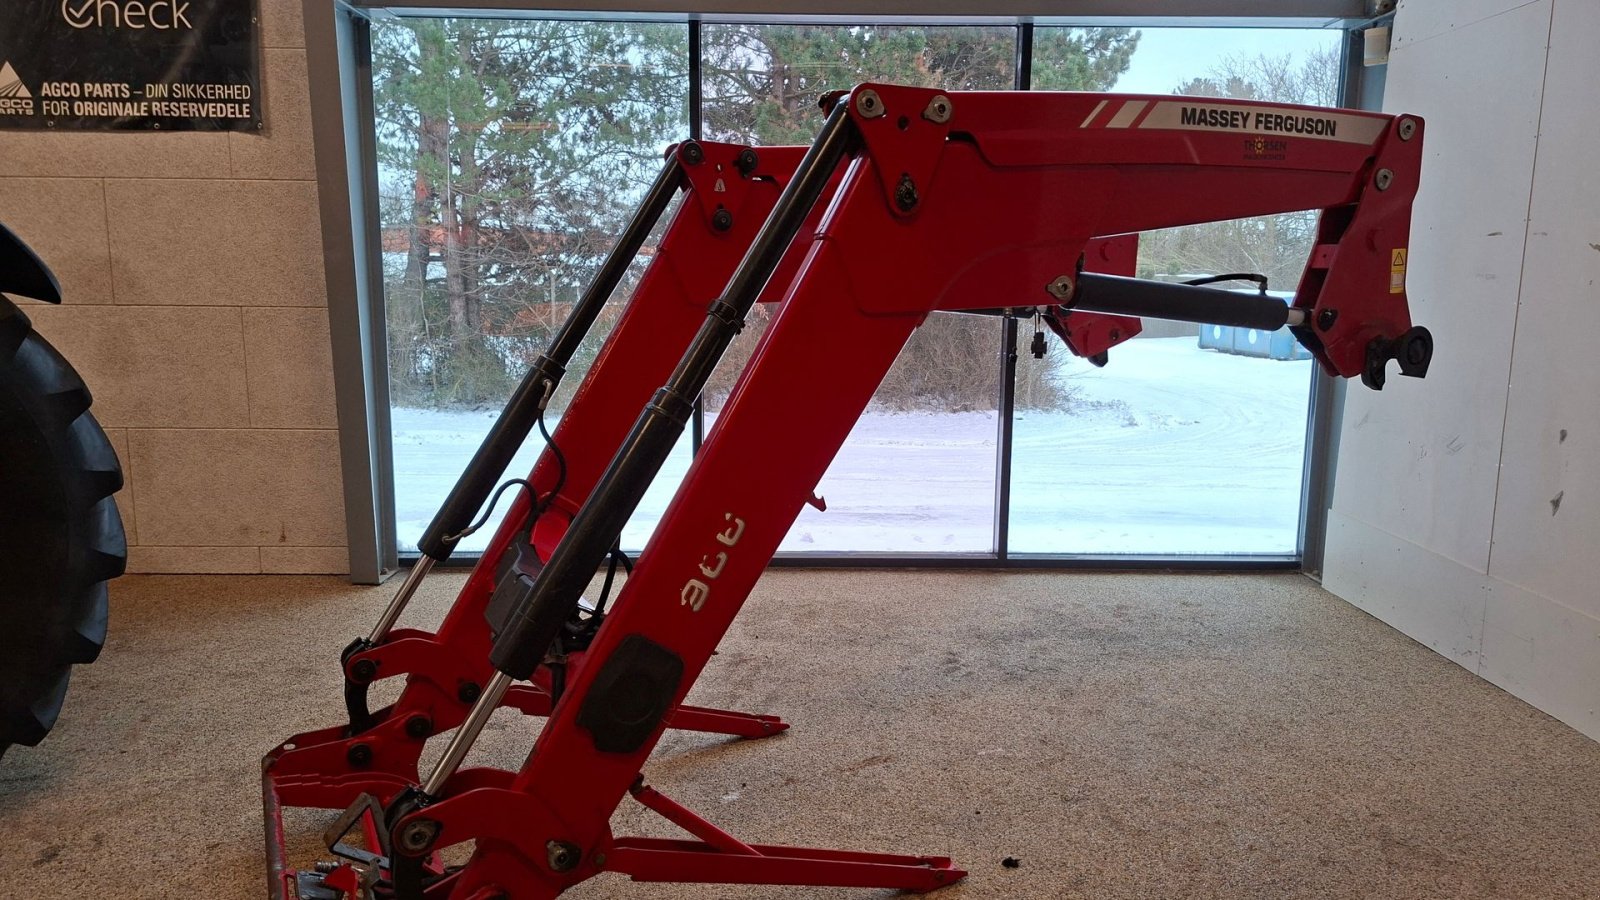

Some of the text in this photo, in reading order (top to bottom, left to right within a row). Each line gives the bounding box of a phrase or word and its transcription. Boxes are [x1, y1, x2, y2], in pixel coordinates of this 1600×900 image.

[62, 0, 193, 29] Check
[41, 82, 80, 98] AGCO
[85, 83, 130, 98] PARTS
[146, 84, 169, 98] DIN
[172, 84, 251, 100] SIKKERHED
[0, 99, 34, 109] GCO
[0, 108, 34, 116] ARTS
[42, 100, 251, 118] FOR ORIGINALE RESERVEDELE
[1181, 107, 1337, 136] MASSEY FERGUSON
